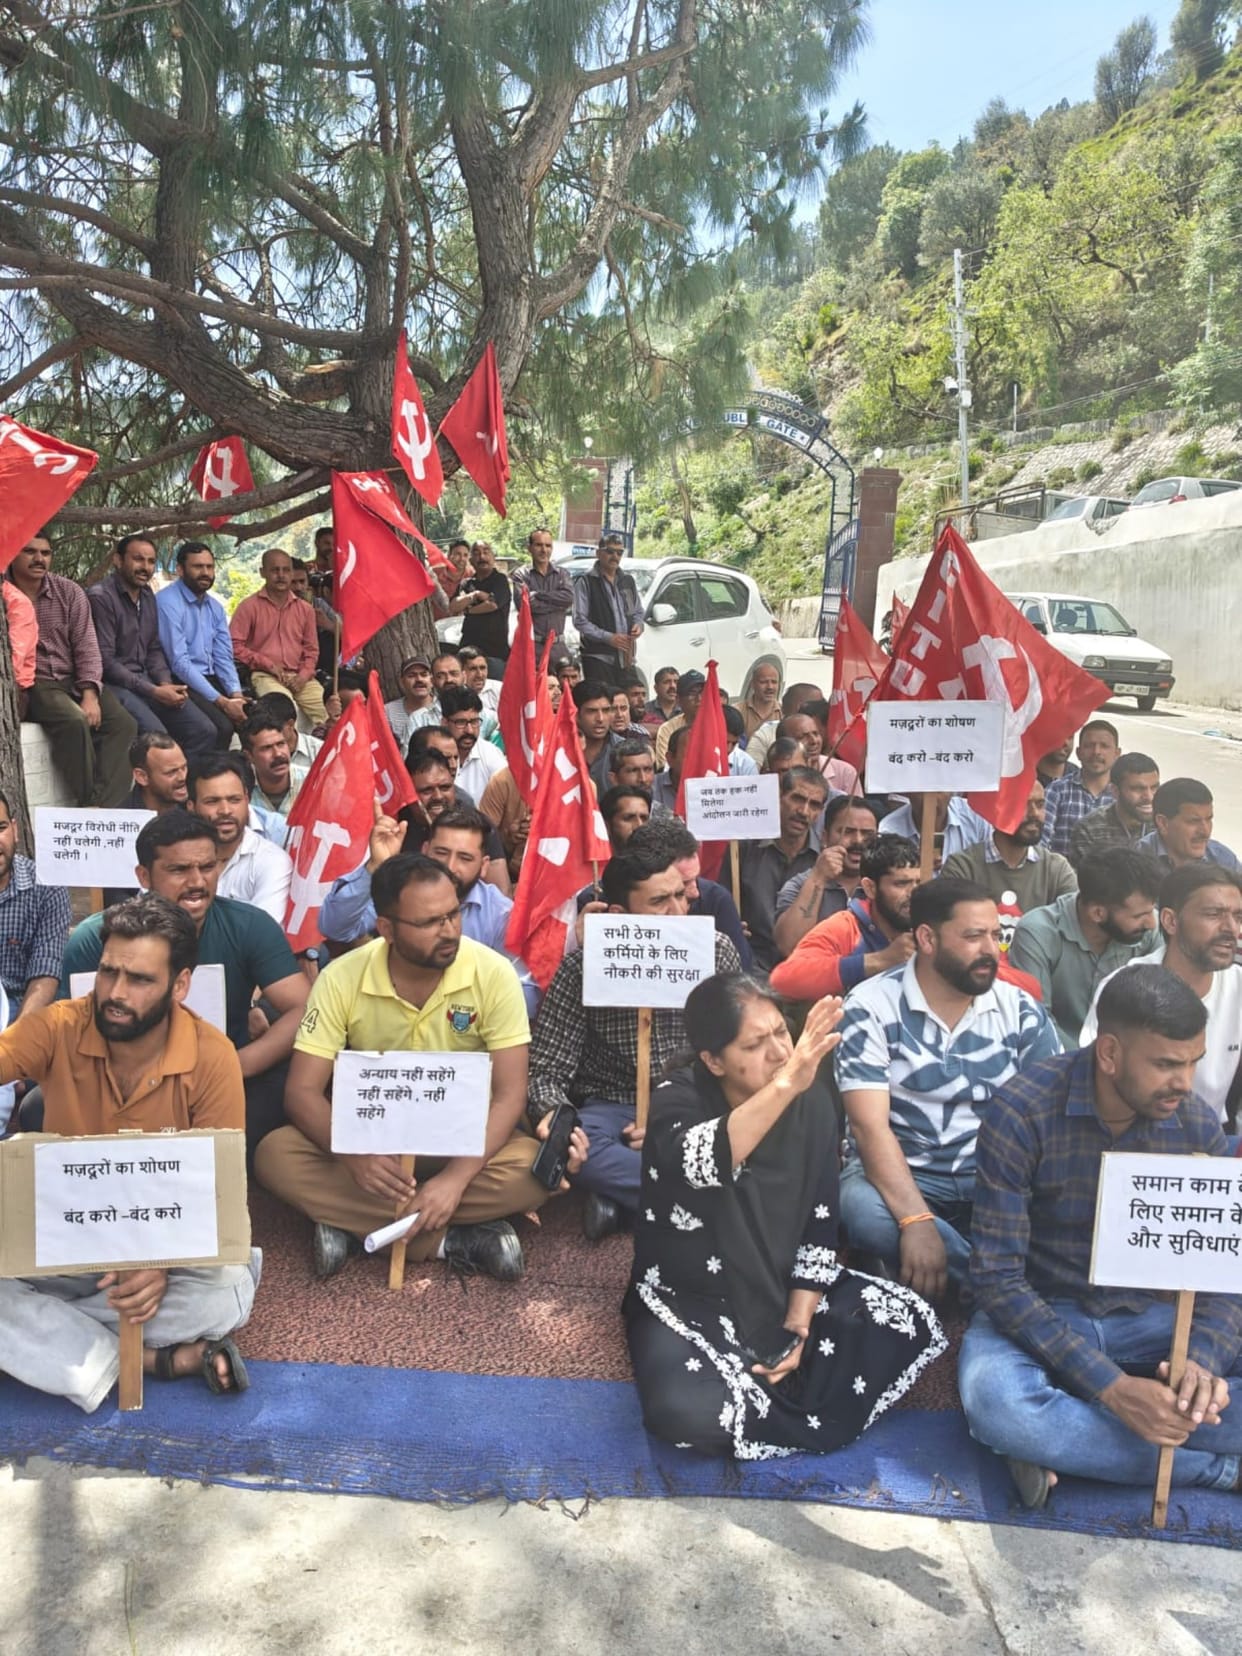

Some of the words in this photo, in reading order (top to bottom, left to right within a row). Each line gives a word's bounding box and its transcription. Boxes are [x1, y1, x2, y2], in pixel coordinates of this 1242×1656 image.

[766, 419, 798, 439] GATE
[927, 718, 942, 728] का
[944, 714, 976, 728] शोषण
[888, 752, 903, 764] बंद
[906, 749, 926, 762] करो
[953, 749, 974, 762] करो
[85, 820, 116, 832] विरोधी
[119, 822, 140, 832] नीति
[74, 835, 101, 847] चलेगी
[53, 849, 80, 860] चलेगी
[603, 924, 630, 940] सभी
[633, 924, 661, 940] ठेका
[603, 944, 645, 960] कर्मियों
[648, 944, 661, 960] के
[664, 945, 688, 963] लिए
[603, 963, 641, 980] नौकरी
[645, 964, 663, 980] की
[666, 968, 700, 983] सुरक्षा
[359, 1068, 398, 1080] अन्याय
[401, 1066, 424, 1082] नहीं
[426, 1066, 456, 1082] सहेंगे
[357, 1085, 382, 1101] नहीं
[383, 1085, 413, 1100] सहेंगे
[423, 1087, 447, 1103] नहीं
[356, 1104, 386, 1120] सहेंगे
[115, 1161, 134, 1175] का
[139, 1156, 181, 1174] शोषण
[1131, 1175, 1185, 1193] समान
[1189, 1177, 1232, 1195] काम
[64, 1208, 85, 1224] बंद
[89, 1205, 118, 1223] करो
[154, 1202, 182, 1220] करो
[1129, 1198, 1165, 1224] लिए
[1170, 1205, 1225, 1224] समान
[1127, 1225, 1163, 1249] और
[1168, 1229, 1242, 1256] सुविधाएं
